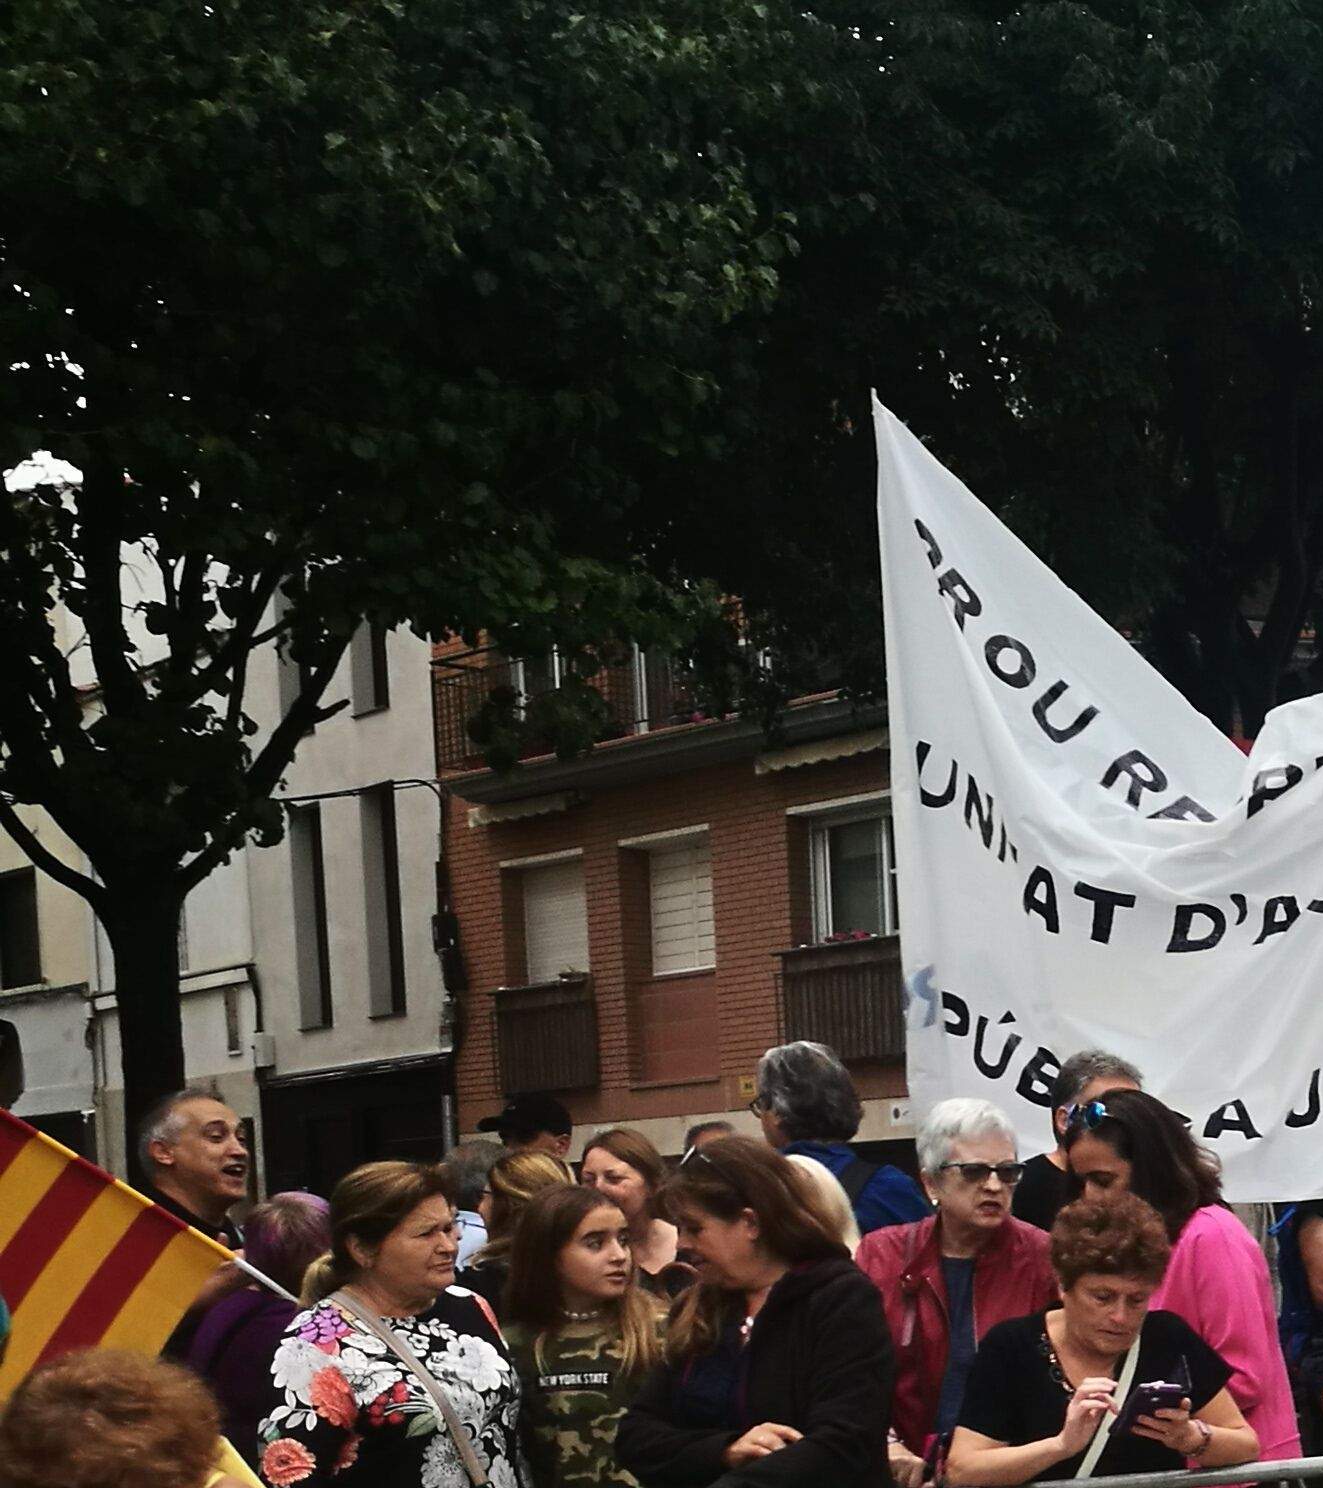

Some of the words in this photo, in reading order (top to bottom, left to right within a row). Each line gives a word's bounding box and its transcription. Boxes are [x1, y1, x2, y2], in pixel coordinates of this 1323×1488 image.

[916, 740, 1135, 945] UNIAT
[539, 1374, 558, 1387] NEW
[559, 1373, 582, 1385] YORK
[584, 1373, 609, 1385] STATE
